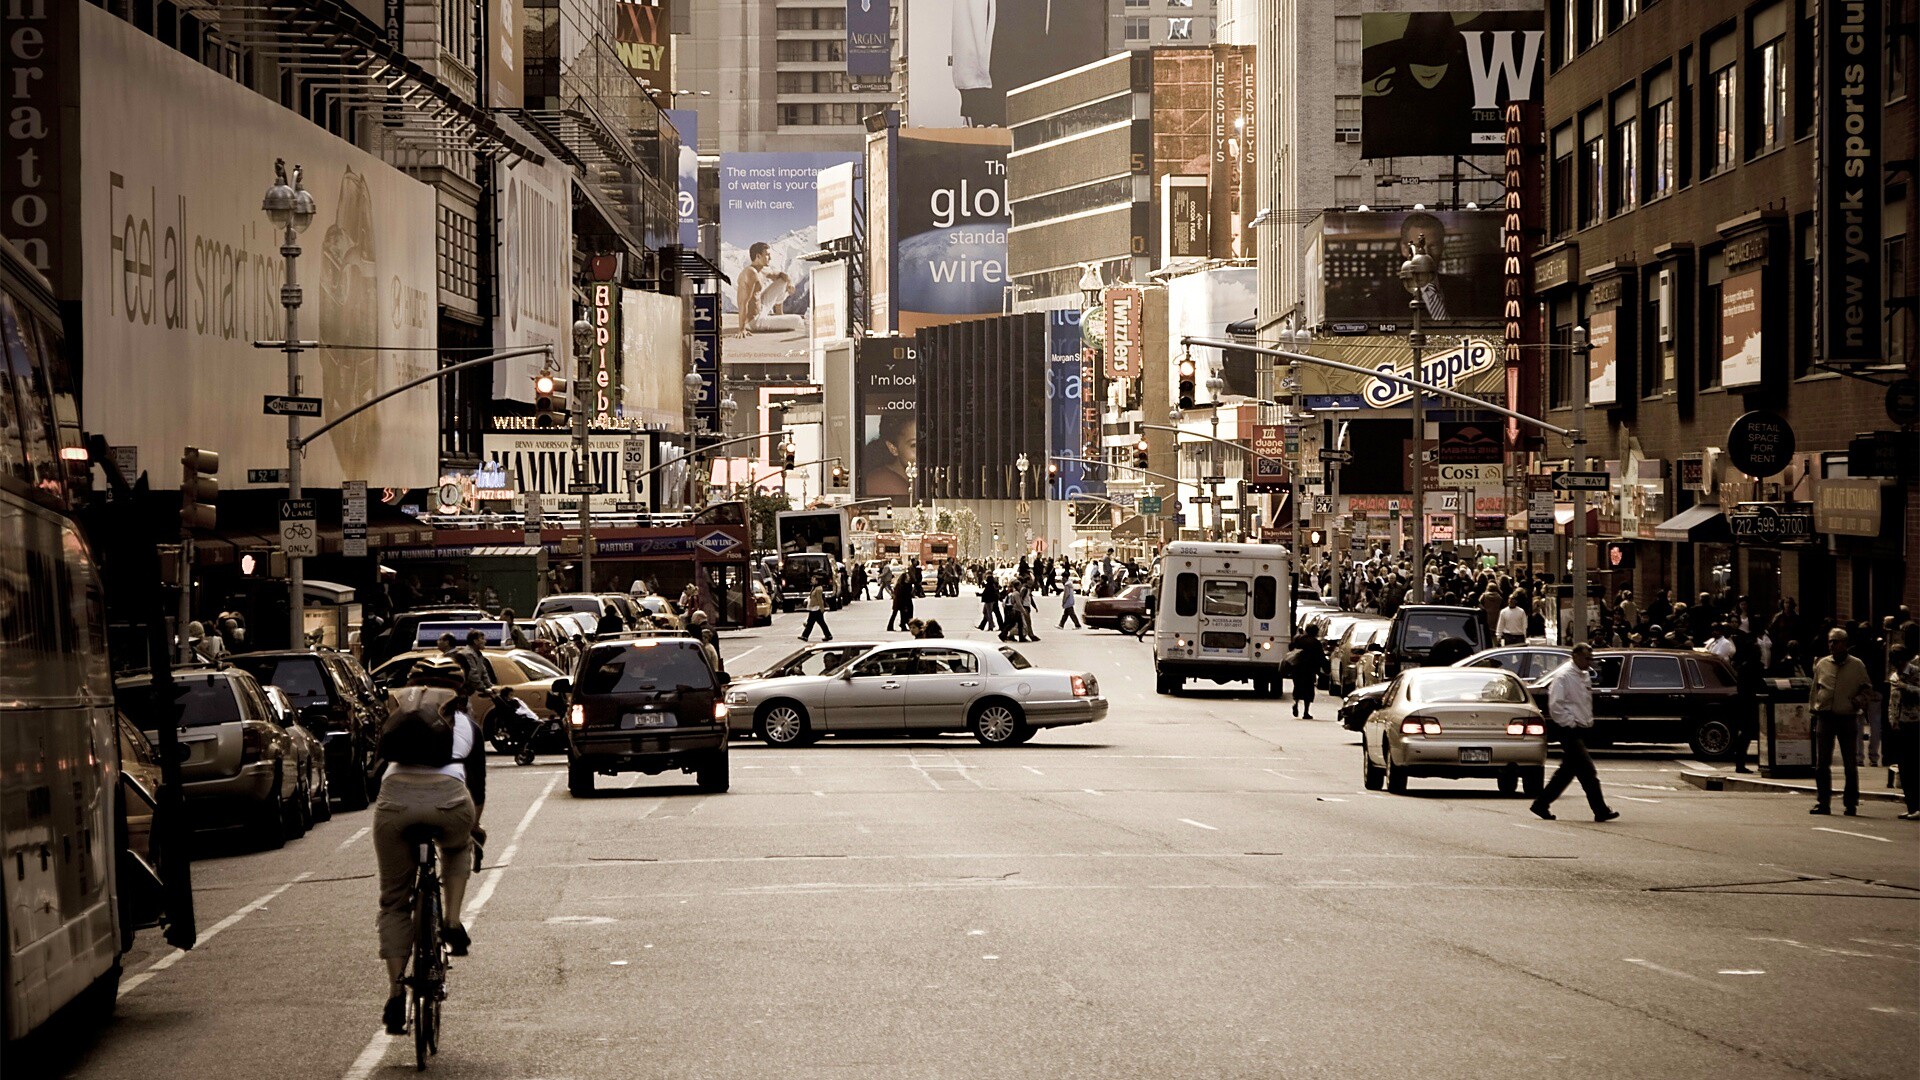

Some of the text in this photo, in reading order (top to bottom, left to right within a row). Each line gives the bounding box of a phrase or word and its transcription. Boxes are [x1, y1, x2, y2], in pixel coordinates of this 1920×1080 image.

[850, 32, 886, 44] ARGENT
[1460, 31, 1544, 109] W
[1216, 62, 1225, 162] HERSHEYS
[1245, 63, 1255, 163] HERSHEYS
[1841, 64, 1872, 178] sports
[727, 167, 746, 177] The
[750, 168, 775, 177] most
[728, 181, 738, 190] of
[741, 182, 769, 190] water
[773, 181, 782, 190] is
[785, 182, 808, 192] your
[729, 200, 795, 210] Fill with care.
[1840, 189, 1870, 264] york
[110, 171, 156, 325] Feel
[165, 194, 188, 330] all
[195, 224, 248, 342] smart
[1841, 277, 1864, 347] new
[1113, 295, 1134, 371] Twizzlers
[1051, 354, 1074, 364] Morgan
[871, 374, 891, 386] I'm
[272, 401, 314, 411] ONE WAY
[1748, 423, 1780, 433] RETAIL
[1255, 438, 1283, 447] duane
[1748, 433, 1780, 443] SPACE
[1256, 447, 1283, 455] reade
[1753, 443, 1774, 453] FOR
[625, 452, 642, 462] 30
[1750, 454, 1777, 463] RENT
[250, 471, 256, 480] W
[258, 470, 268, 481] 52
[1441, 465, 1480, 480] Così
[1560, 477, 1577, 485] ONE
[291, 510, 314, 518] LANE
[1736, 517, 1803, 534] 212.599.3700
[288, 545, 309, 553] ONLY
[600, 542, 634, 552] PARTNER
[653, 540, 677, 550] asics
[388, 551, 400, 559] MY
[402, 549, 436, 559] RUNNING
[438, 547, 470, 557] PARTNER
